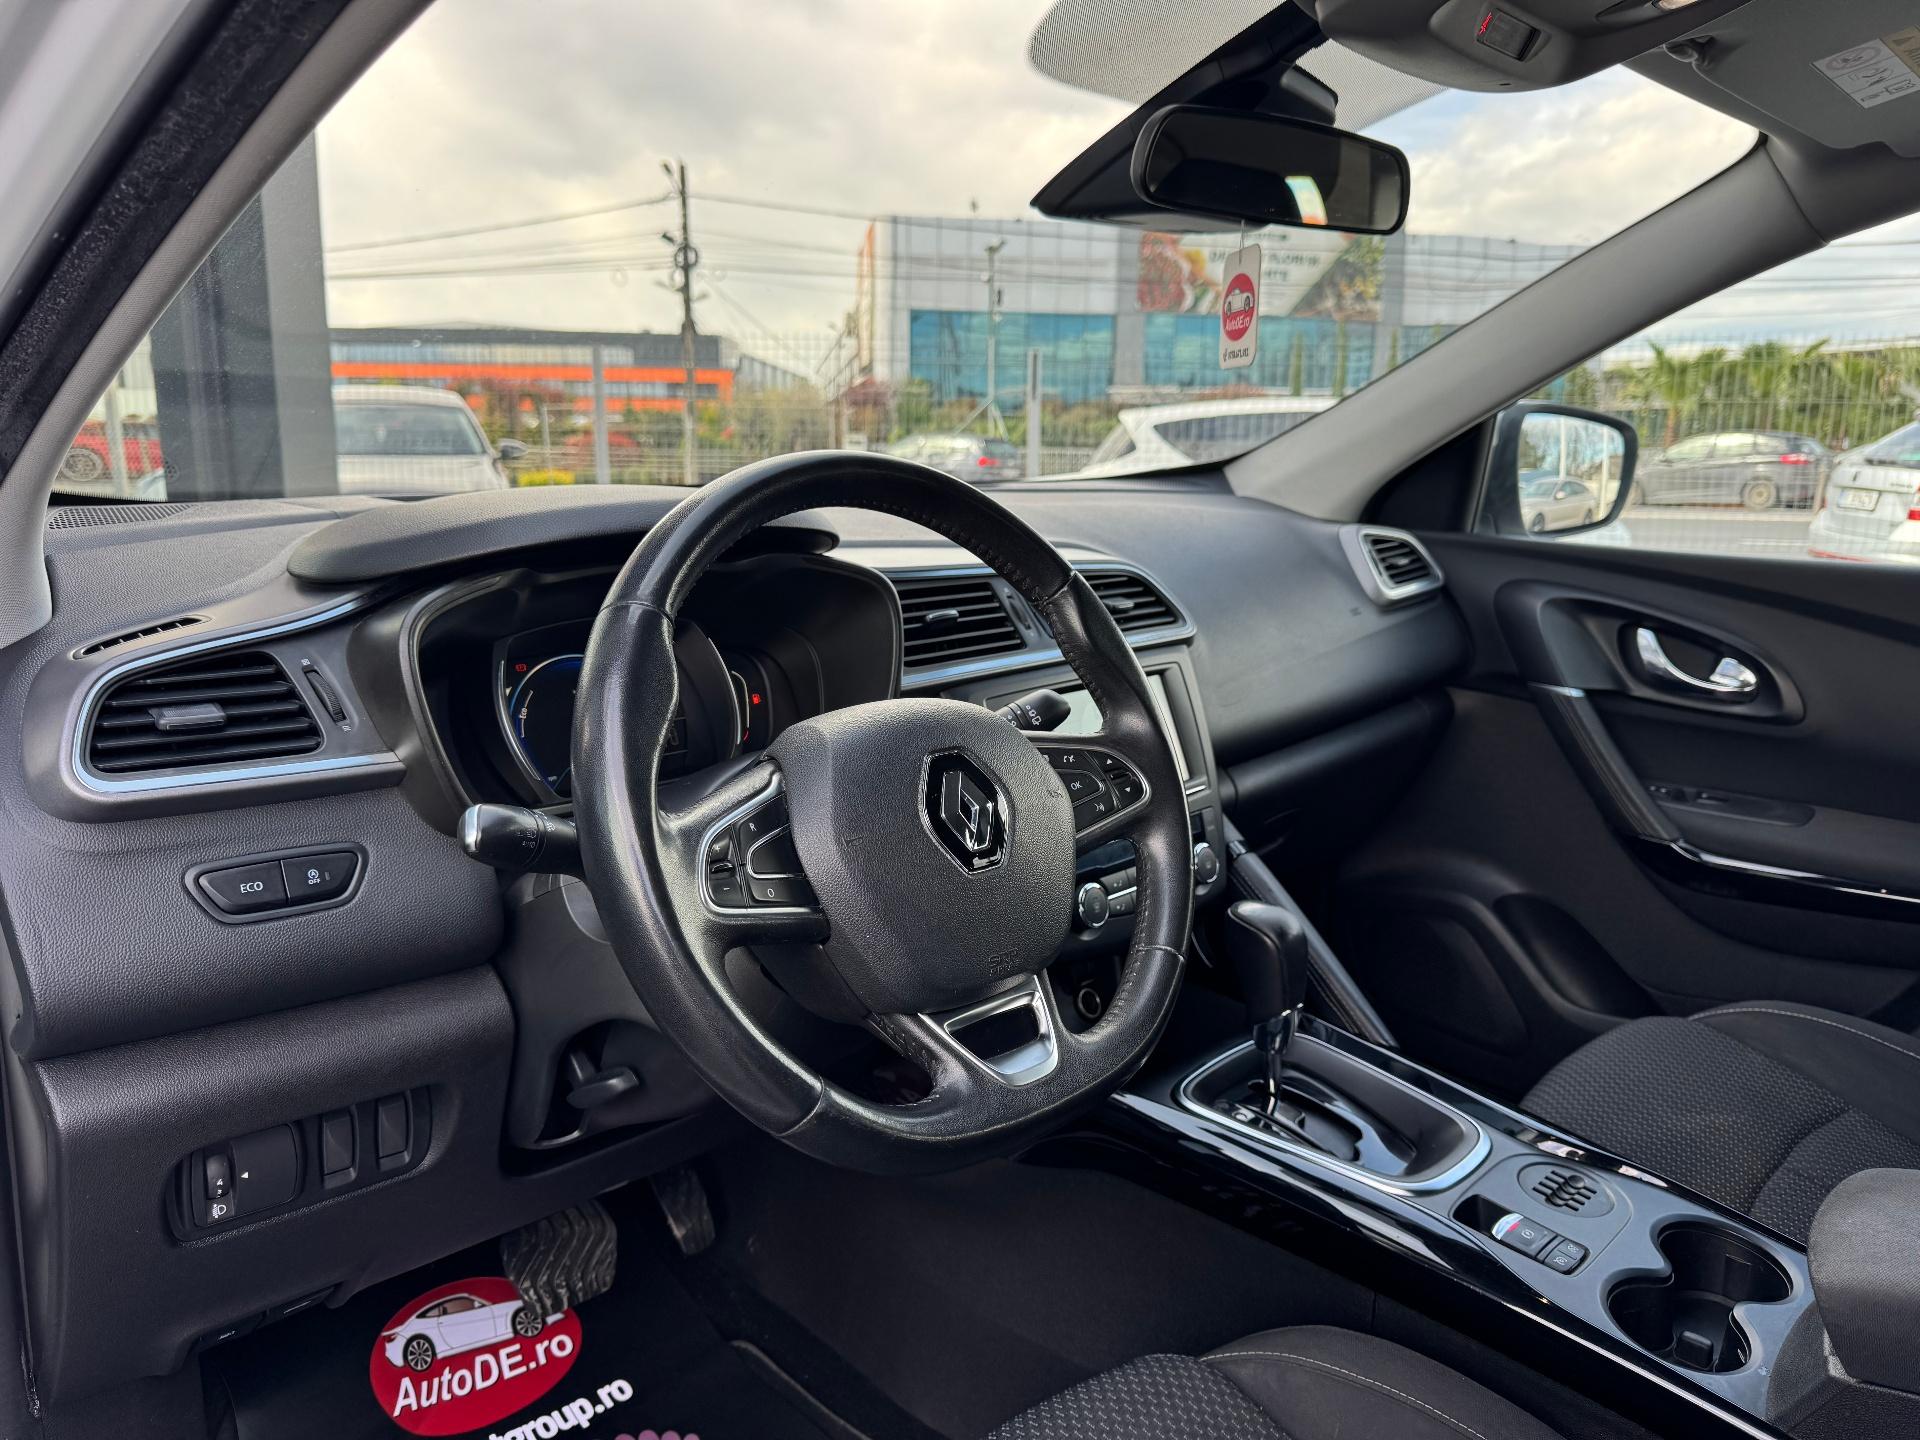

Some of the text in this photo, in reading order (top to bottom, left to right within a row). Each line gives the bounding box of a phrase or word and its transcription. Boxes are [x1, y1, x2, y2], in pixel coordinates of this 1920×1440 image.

[1070, 781, 1082, 791] OK
[240, 881, 264, 893] ECO
[393, 1333, 574, 1418] AutoDE.ro
